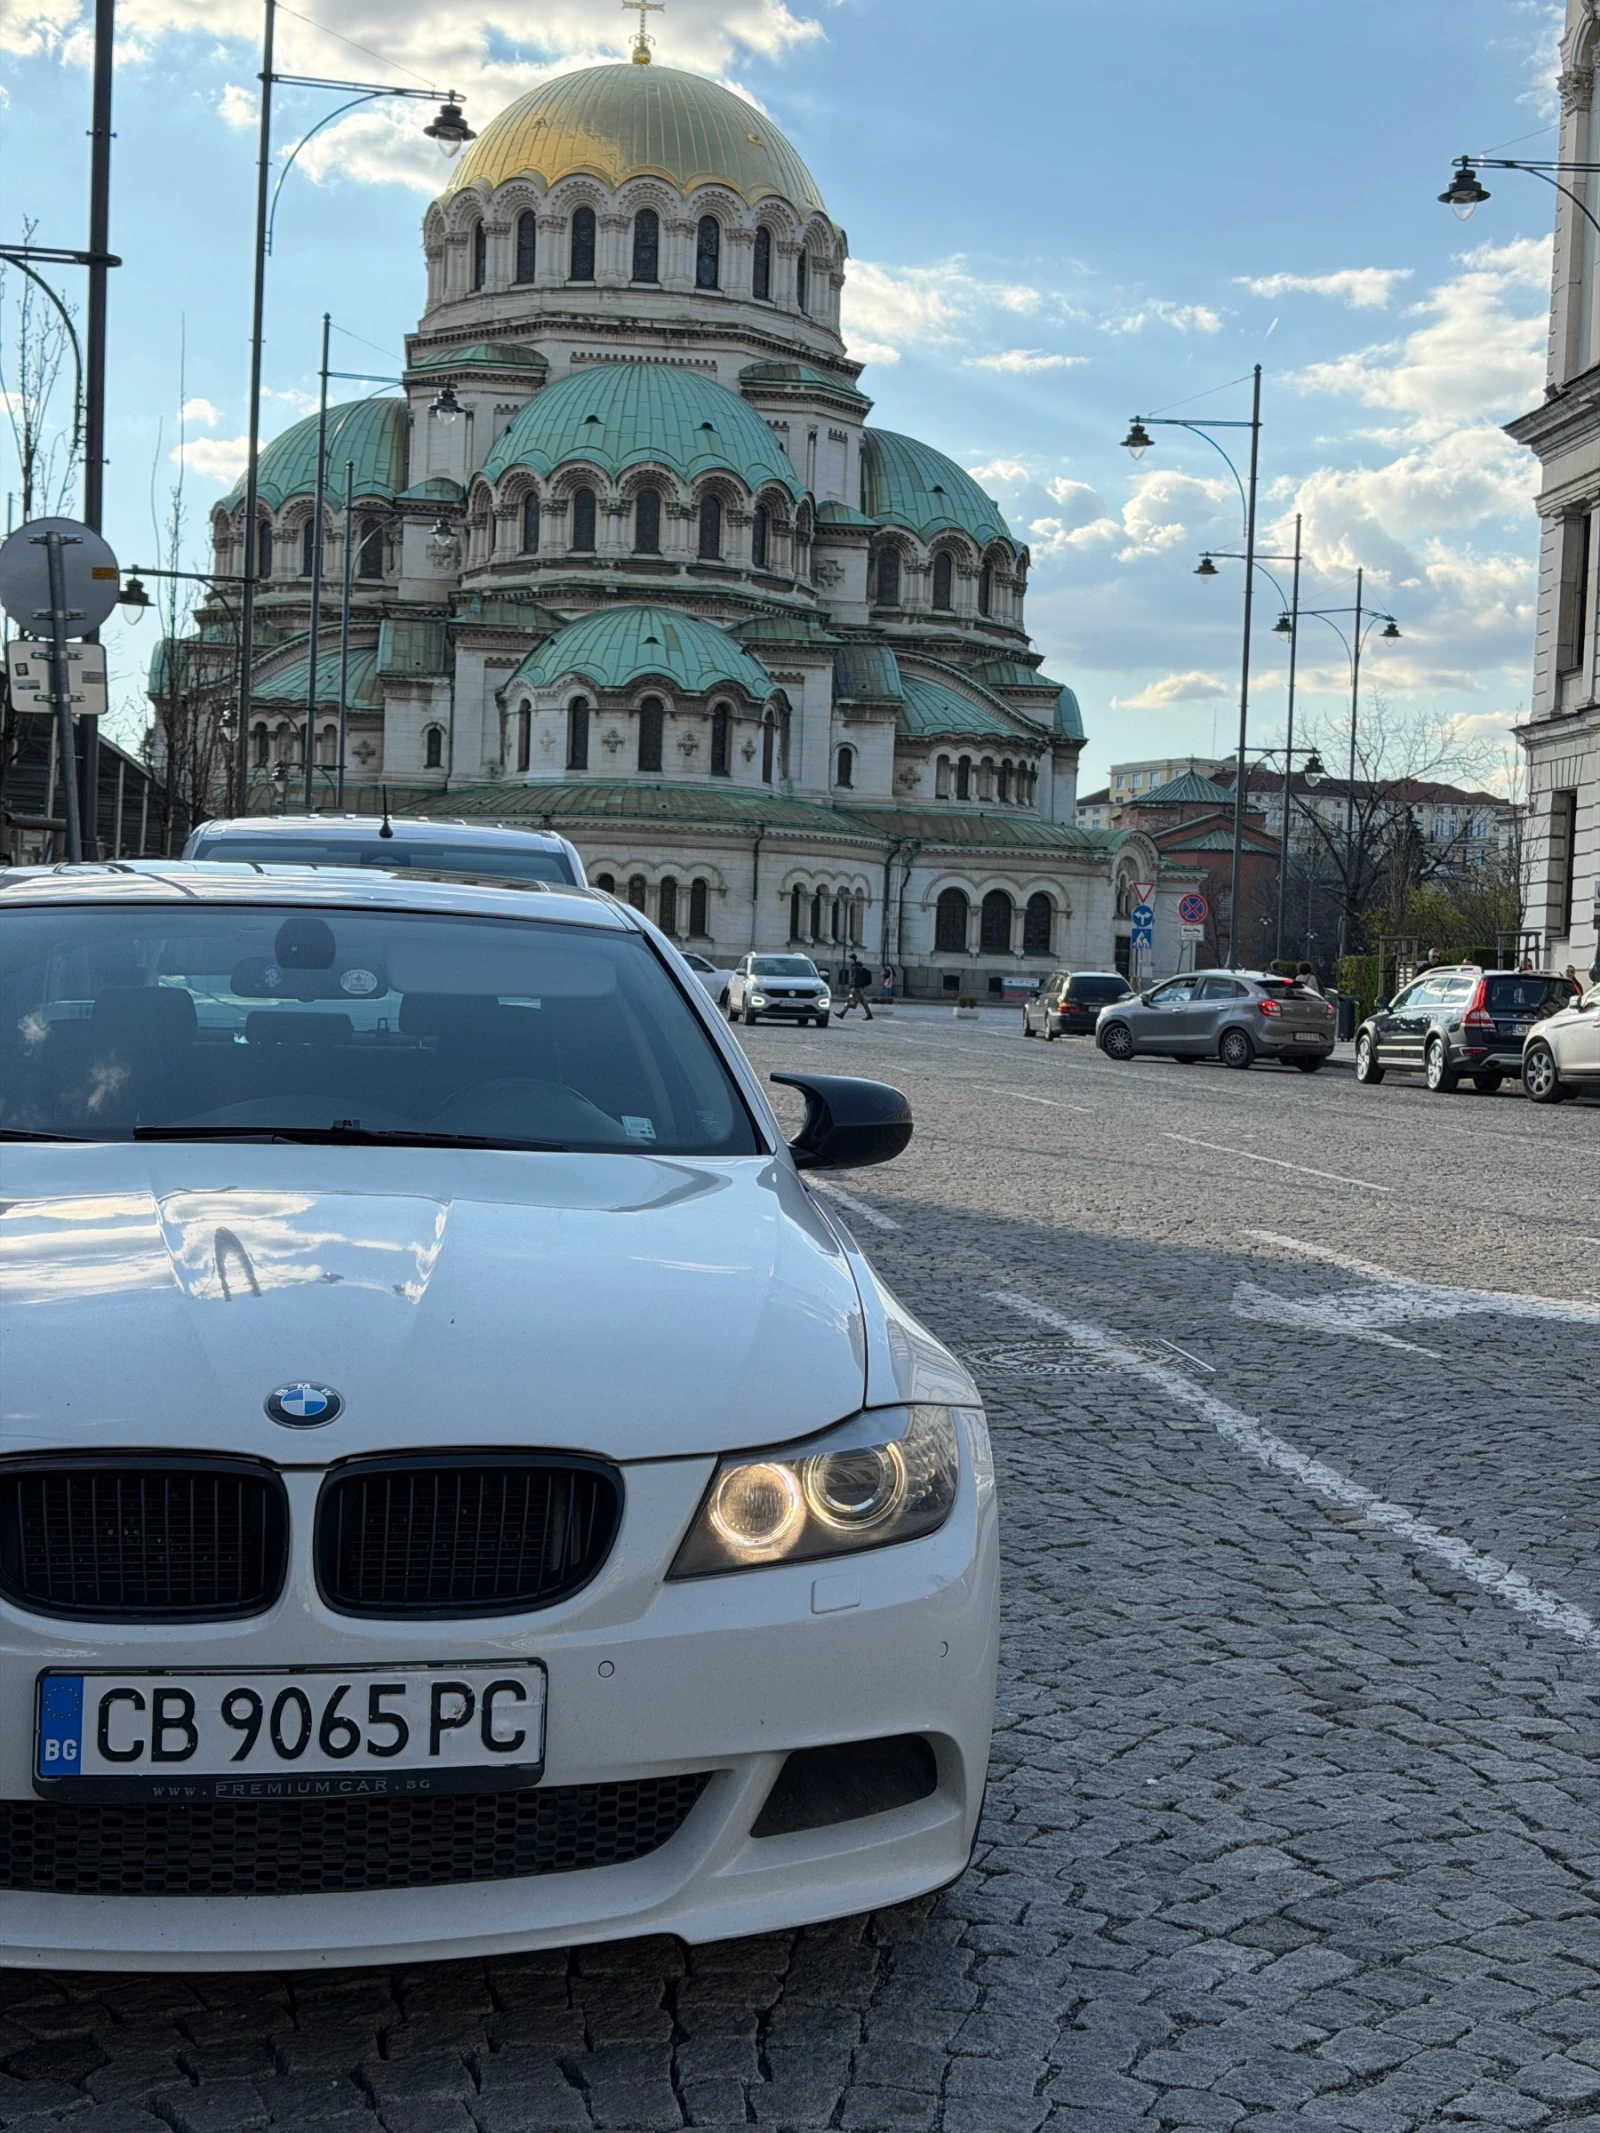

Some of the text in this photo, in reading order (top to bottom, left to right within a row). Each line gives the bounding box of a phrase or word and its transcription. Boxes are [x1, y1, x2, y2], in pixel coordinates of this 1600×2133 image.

[274, 1383, 335, 1397] BMW
[96, 1679, 527, 1763] CB 9065 PC
[44, 1738, 78, 1761] BG
